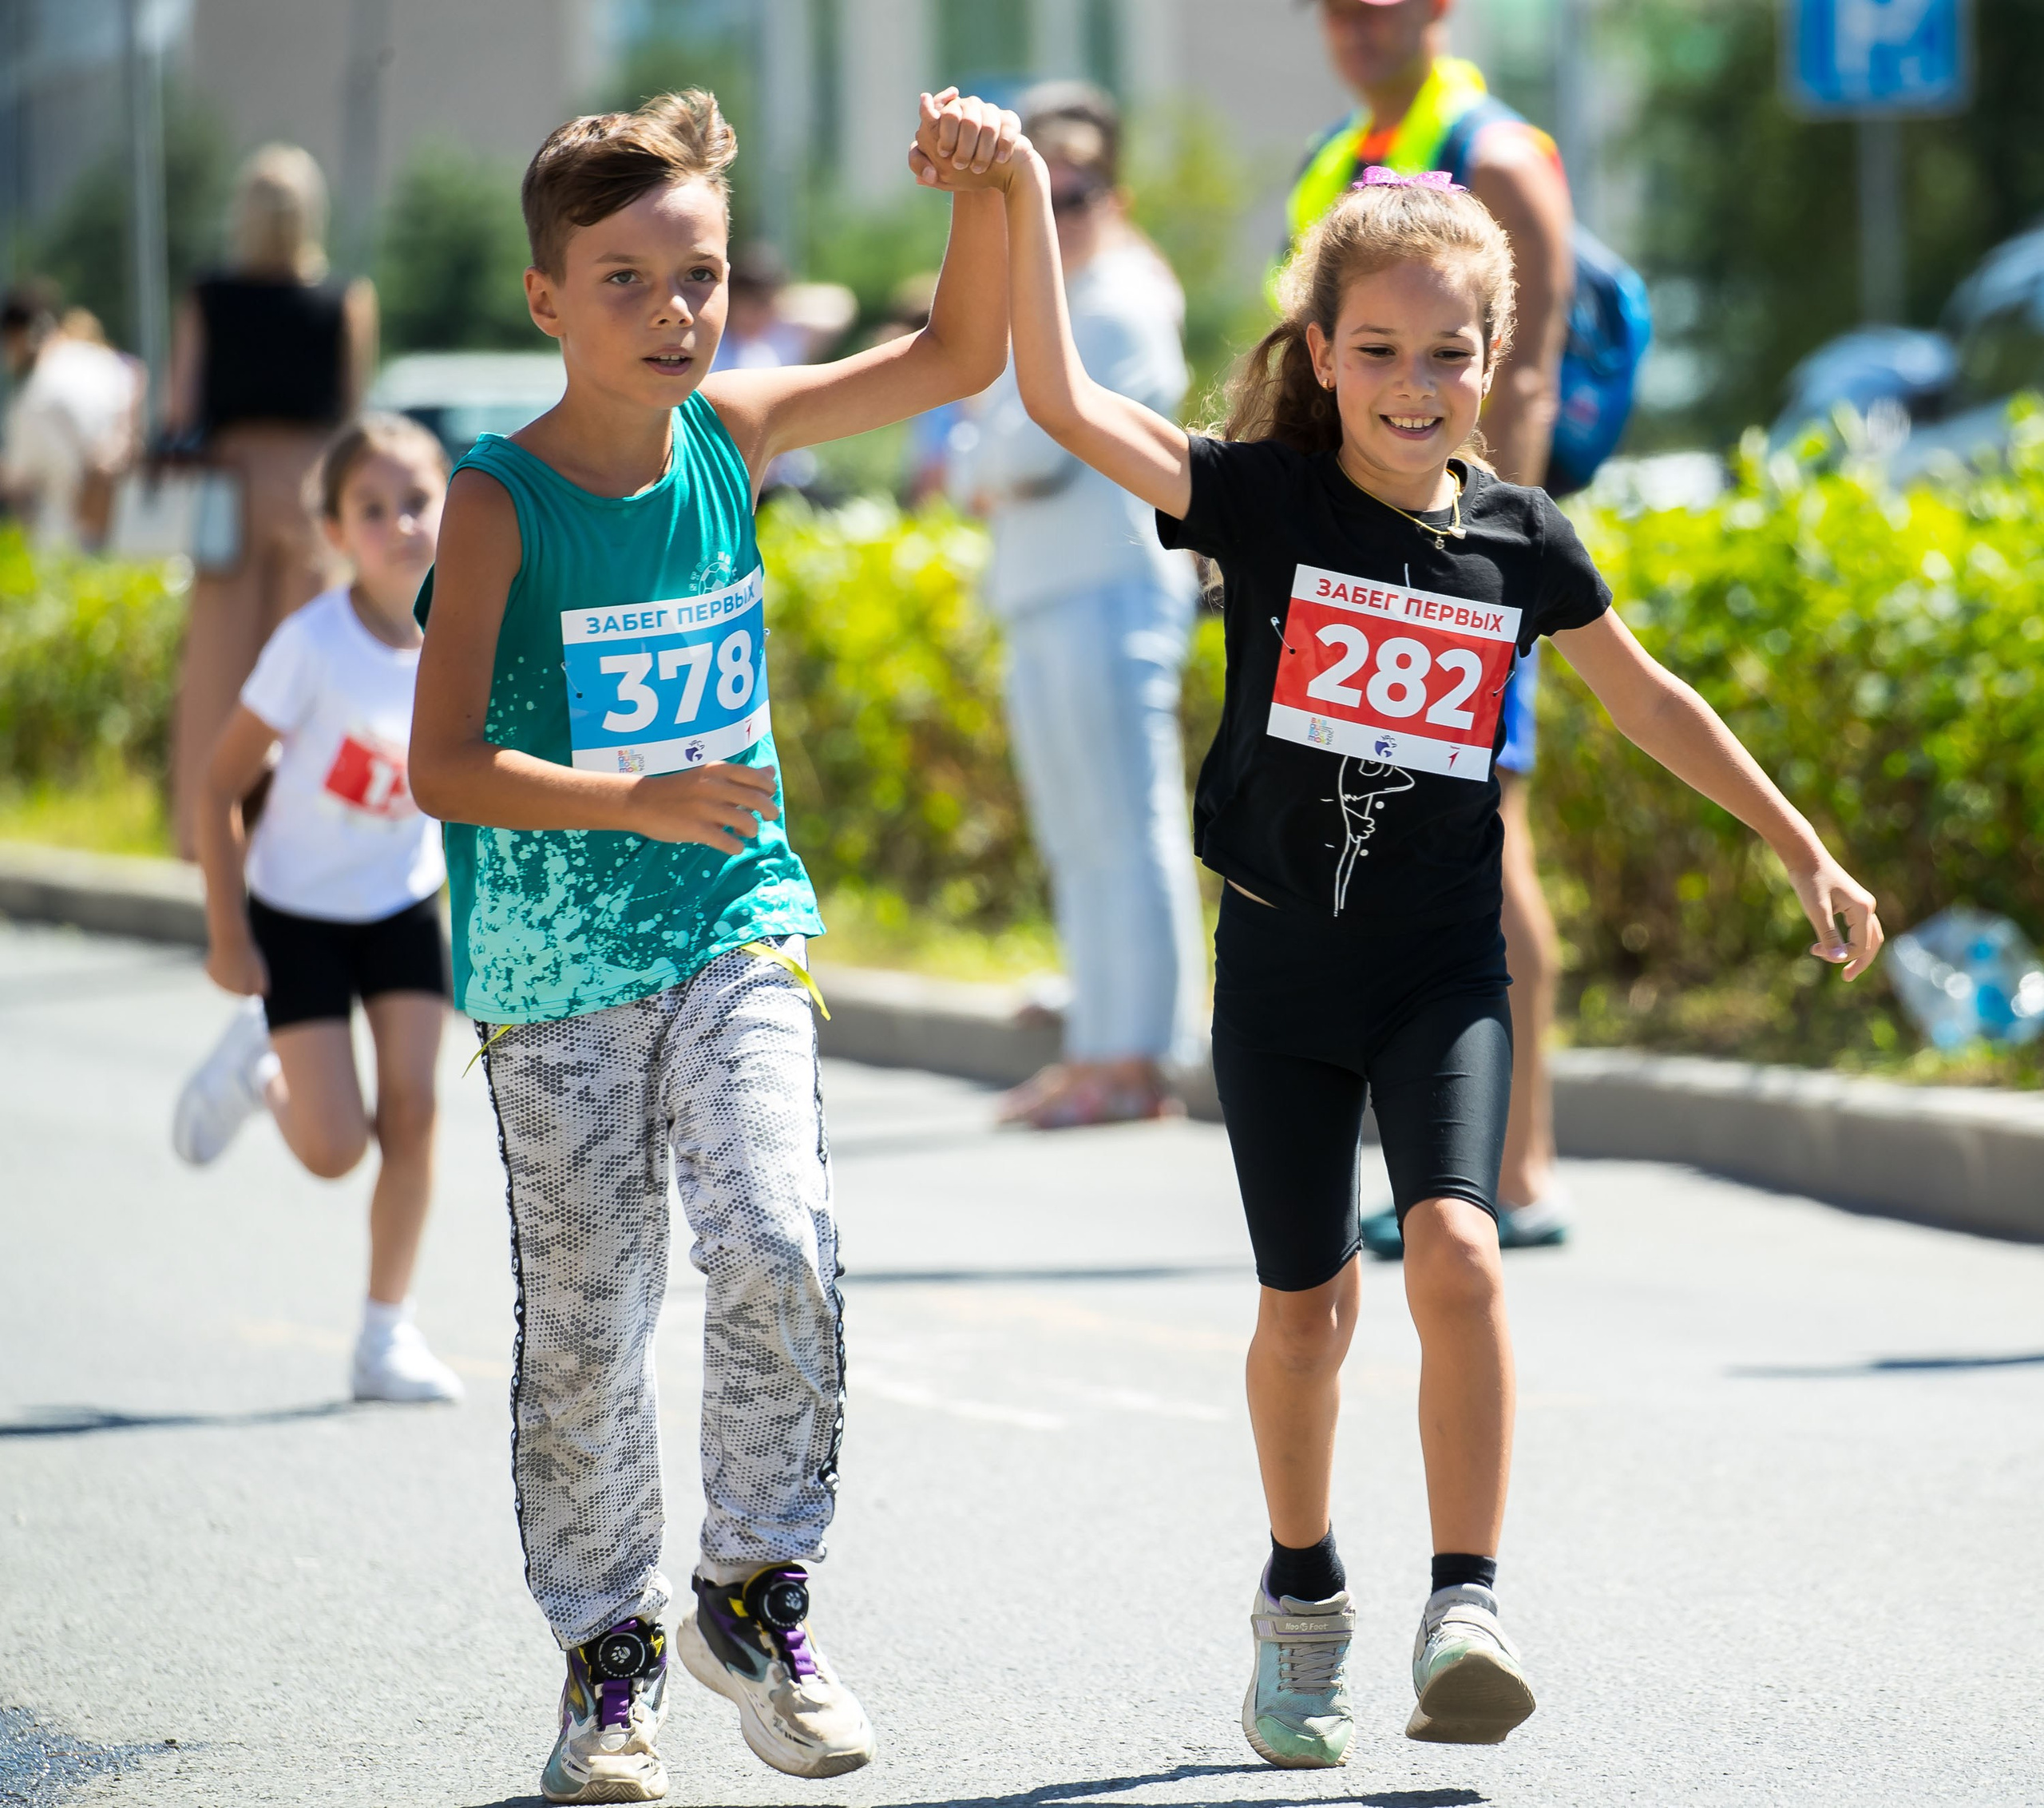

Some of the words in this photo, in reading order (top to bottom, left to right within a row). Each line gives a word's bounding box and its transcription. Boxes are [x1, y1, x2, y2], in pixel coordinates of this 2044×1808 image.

[585, 609, 668, 635] ЗАБЕГ
[677, 581, 755, 625] ПЕРВЫХ
[1316, 578, 1399, 611] ЗАБЕГ
[1404, 597, 1505, 632] ПЕРВЫХ
[600, 629, 755, 733] 378
[1306, 623, 1483, 731] 282
